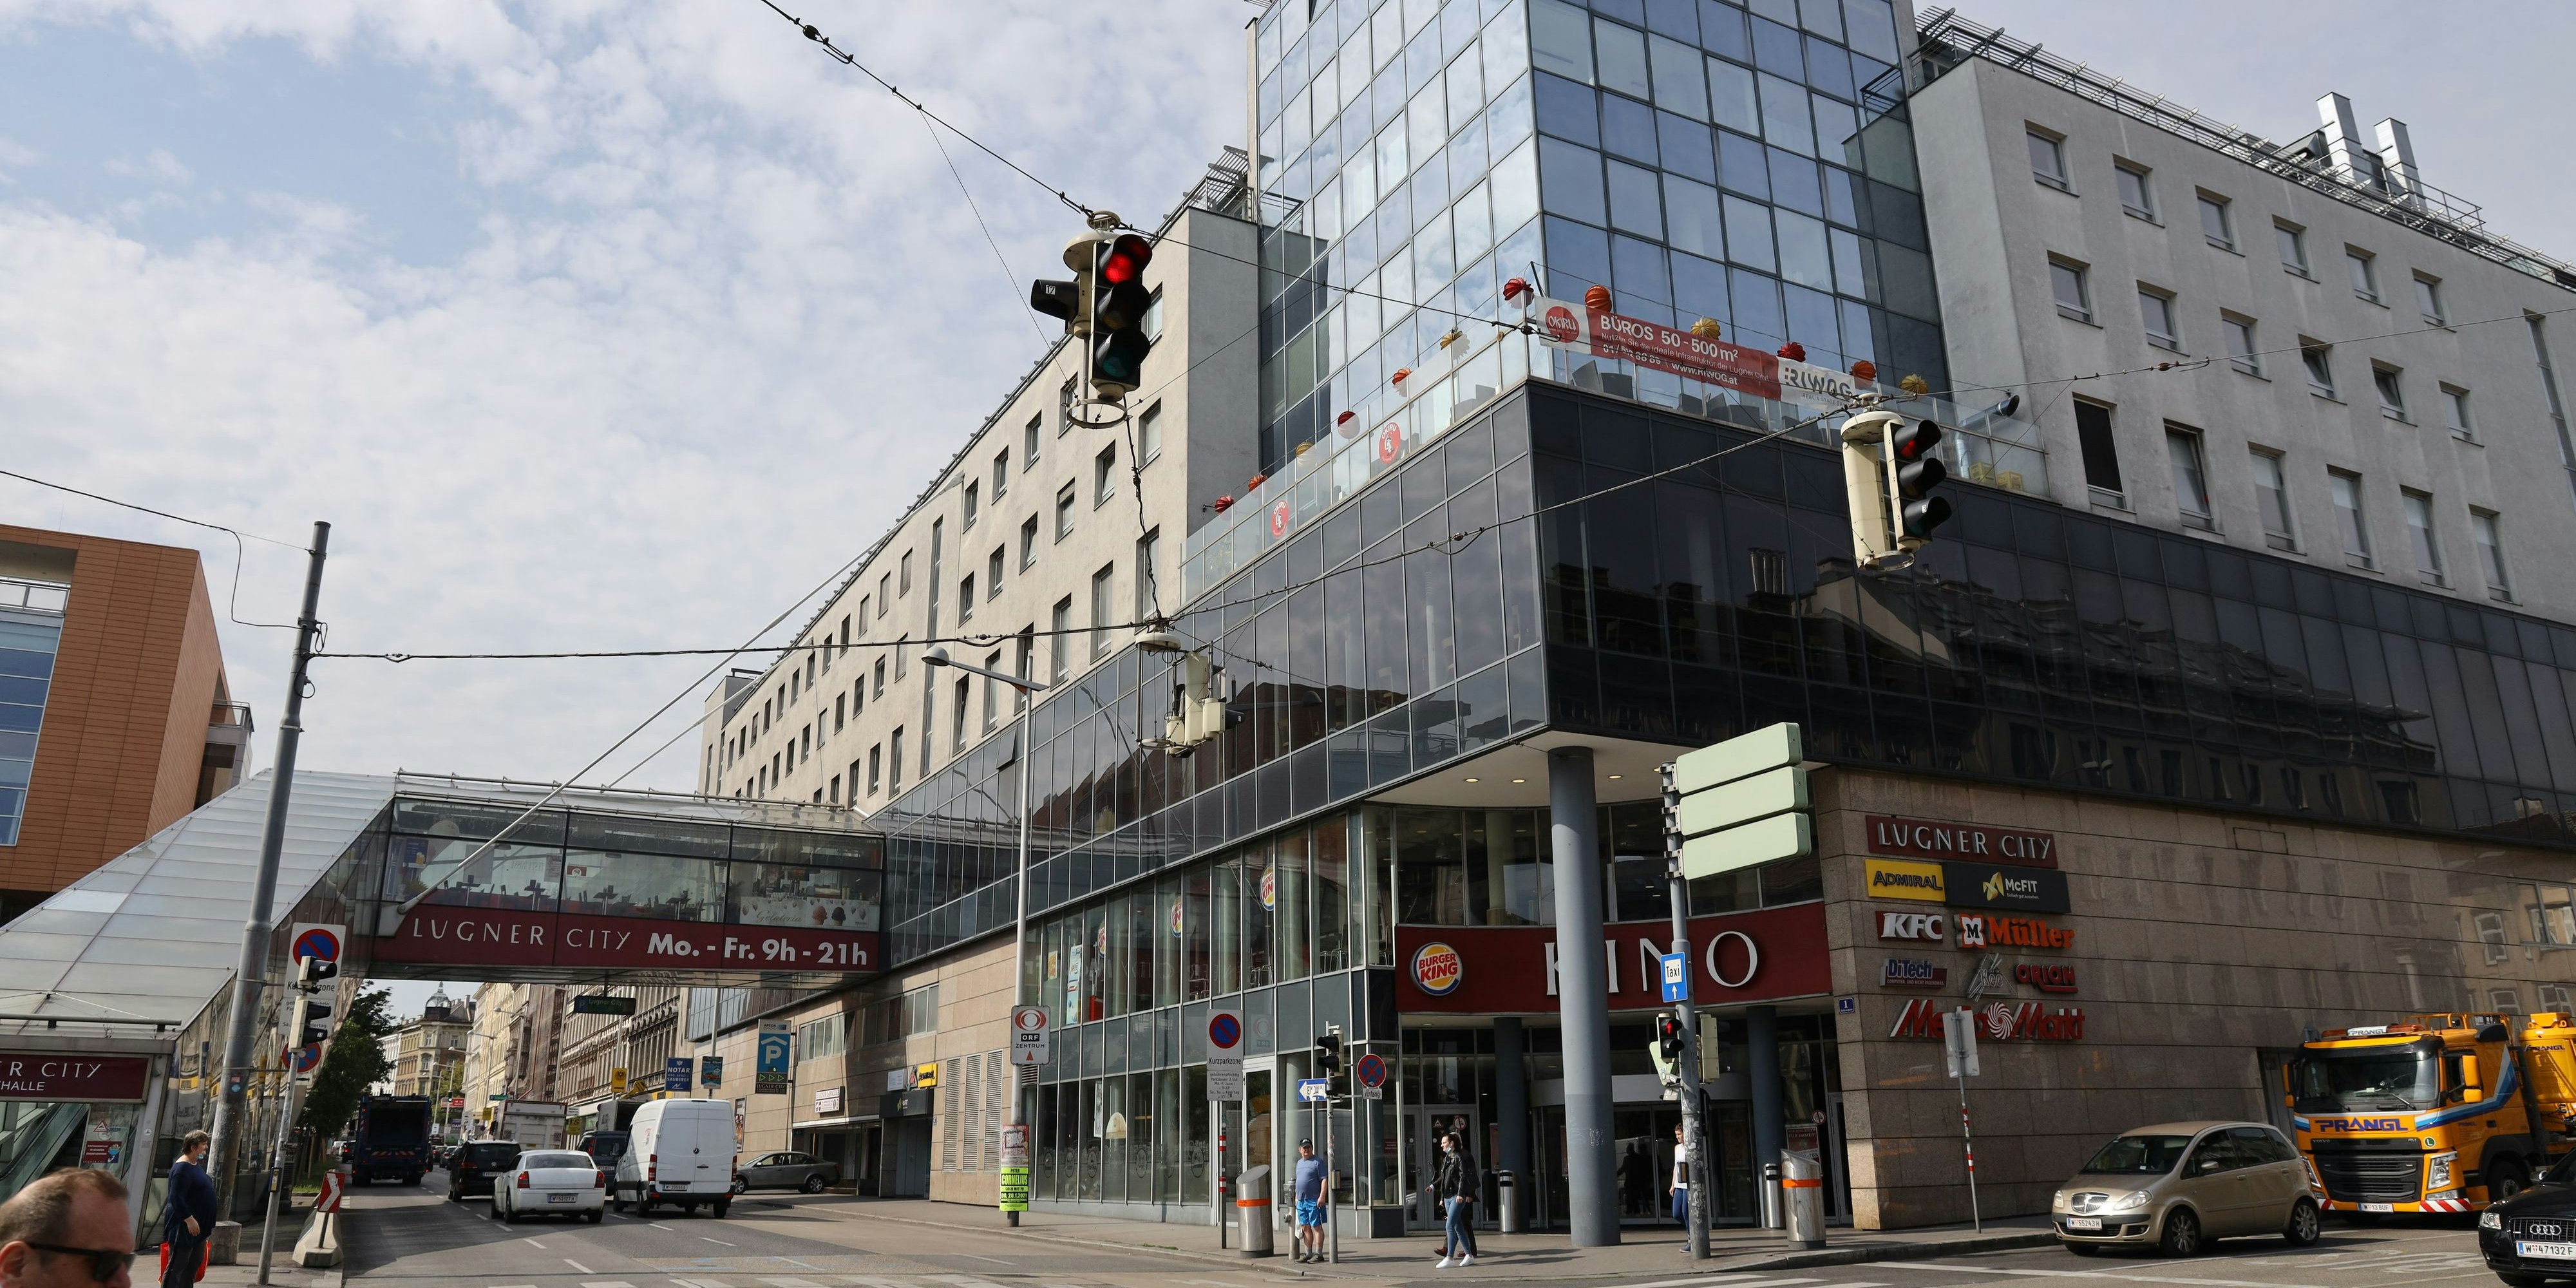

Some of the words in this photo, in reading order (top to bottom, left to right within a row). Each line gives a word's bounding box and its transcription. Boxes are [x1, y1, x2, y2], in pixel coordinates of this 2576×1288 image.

[1548, 315, 1577, 332] OKIRU
[1600, 314, 1654, 341] BÜROS
[1661, 330, 1681, 347] 50
[1691, 338, 1718, 357] 500
[1602, 333, 1626, 344] Nutzen
[1627, 337, 1639, 346] Sie
[1640, 342, 1651, 351] die
[1651, 345, 1674, 356] ideale
[1676, 350, 1716, 367] Infrastruktur
[1729, 365, 1754, 377] Lugner
[1790, 368, 1853, 402] RIWOG
[1381, 424, 1397, 439] OKIRU
[1878, 822, 1989, 855] LUGNER
[1999, 835, 2051, 860] CITY
[1873, 871, 1944, 891] ADMIRAL
[2005, 878, 2038, 893] McFIT
[1882, 912, 1943, 940] KFC
[1987, 916, 2076, 949] Müller
[413, 918, 544, 946] LUGNER
[566, 929, 631, 950] CITY
[647, 933, 699, 957] Mo.
[724, 937, 755, 960] Fr.
[762, 938, 795, 961] 9h
[817, 942, 867, 965] 21h
[1419, 953, 1456, 970] BURGER
[1887, 958, 1933, 978] DiTech
[1420, 962, 1458, 983] KING
[1665, 964, 1680, 978] Taxi
[2016, 963, 2078, 993] ORION
[287, 981, 336, 992] Kukzone
[588, 998, 607, 1007] Lugner
[1844, 1000, 1848, 1009] 1
[1889, 999, 1989, 1040] Mea
[2014, 1002, 2085, 1040] Markt
[765, 1045, 782, 1065] P
[1209, 1057, 1242, 1066] Kurzparkzone
[41, 1062, 103, 1078] CITY
[0, 1081, 46, 1092] HALLE
[2315, 1117, 2409, 1132] PRANGL
[1001, 1174, 1028, 1186] CORNELIUS
[2525, 1244, 2532, 1253] W
